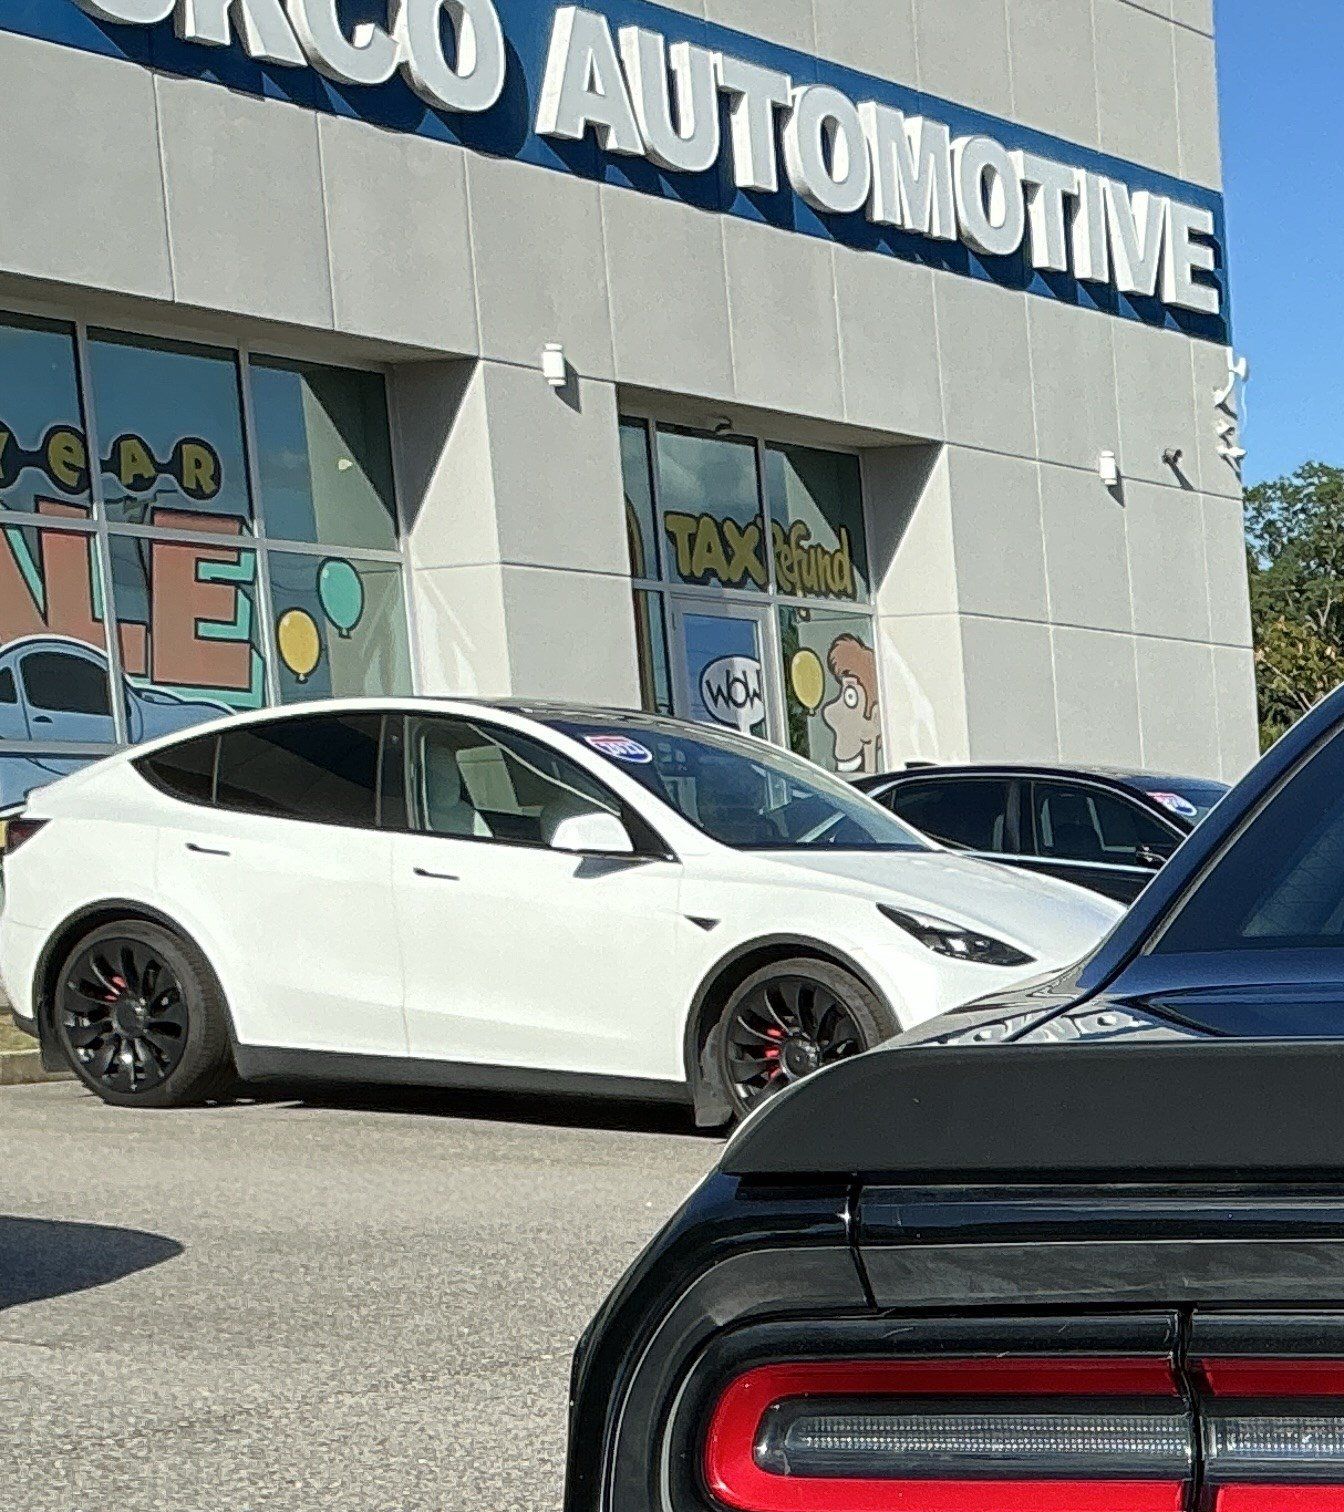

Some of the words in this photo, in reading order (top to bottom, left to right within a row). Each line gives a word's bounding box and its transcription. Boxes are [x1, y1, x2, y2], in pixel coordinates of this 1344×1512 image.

[72, 0, 507, 112] CO
[535, 5, 1219, 314] AUTOMOTIVE
[664, 510, 769, 589] TAX
[705, 669, 762, 709] WOW
